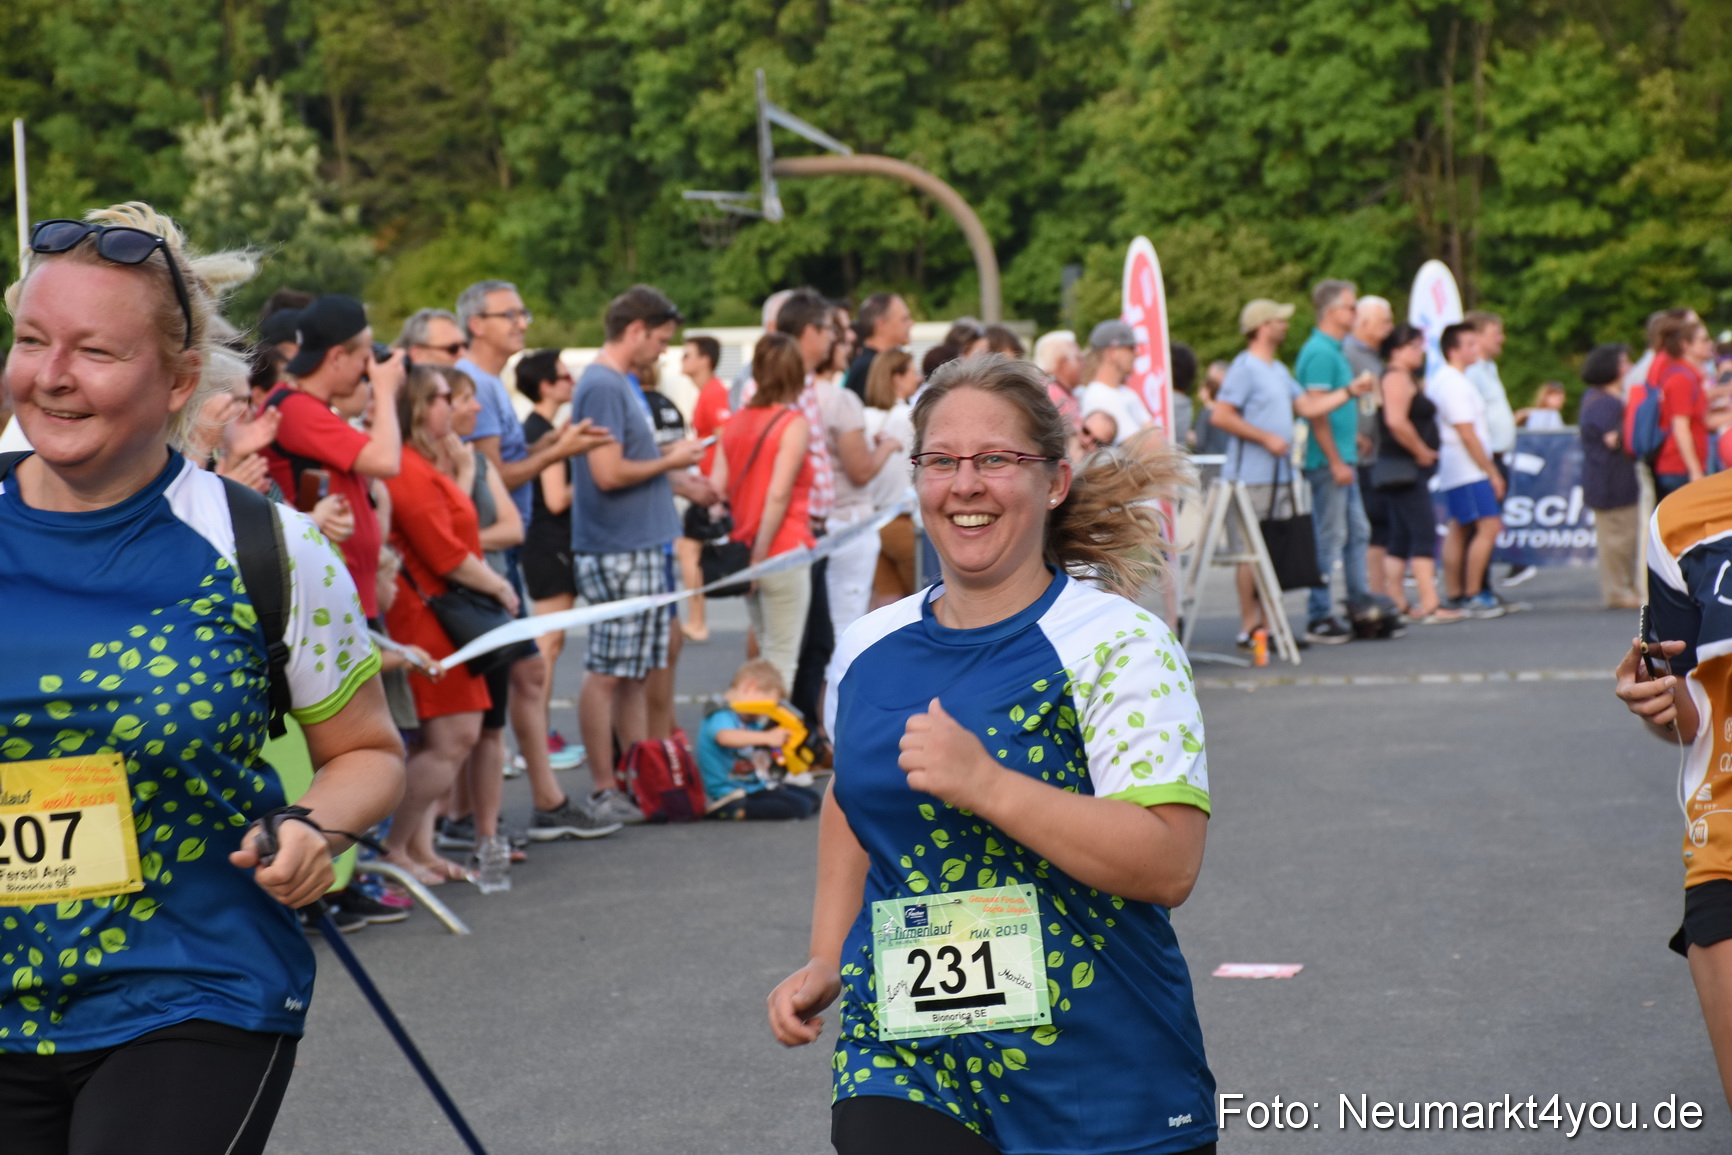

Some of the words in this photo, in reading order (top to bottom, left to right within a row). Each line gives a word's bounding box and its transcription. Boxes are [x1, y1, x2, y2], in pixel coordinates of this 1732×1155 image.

[1502, 485, 1597, 528] sch
[1496, 528, 1598, 549] UTOMO
[79, 792, 116, 808] 2019
[894, 920, 953, 939] firmenlauf
[969, 928, 991, 939] run
[995, 923, 1028, 937] 2019
[907, 941, 996, 998] 231
[932, 1011, 972, 1022] Bionorica
[974, 1009, 988, 1018] SE
